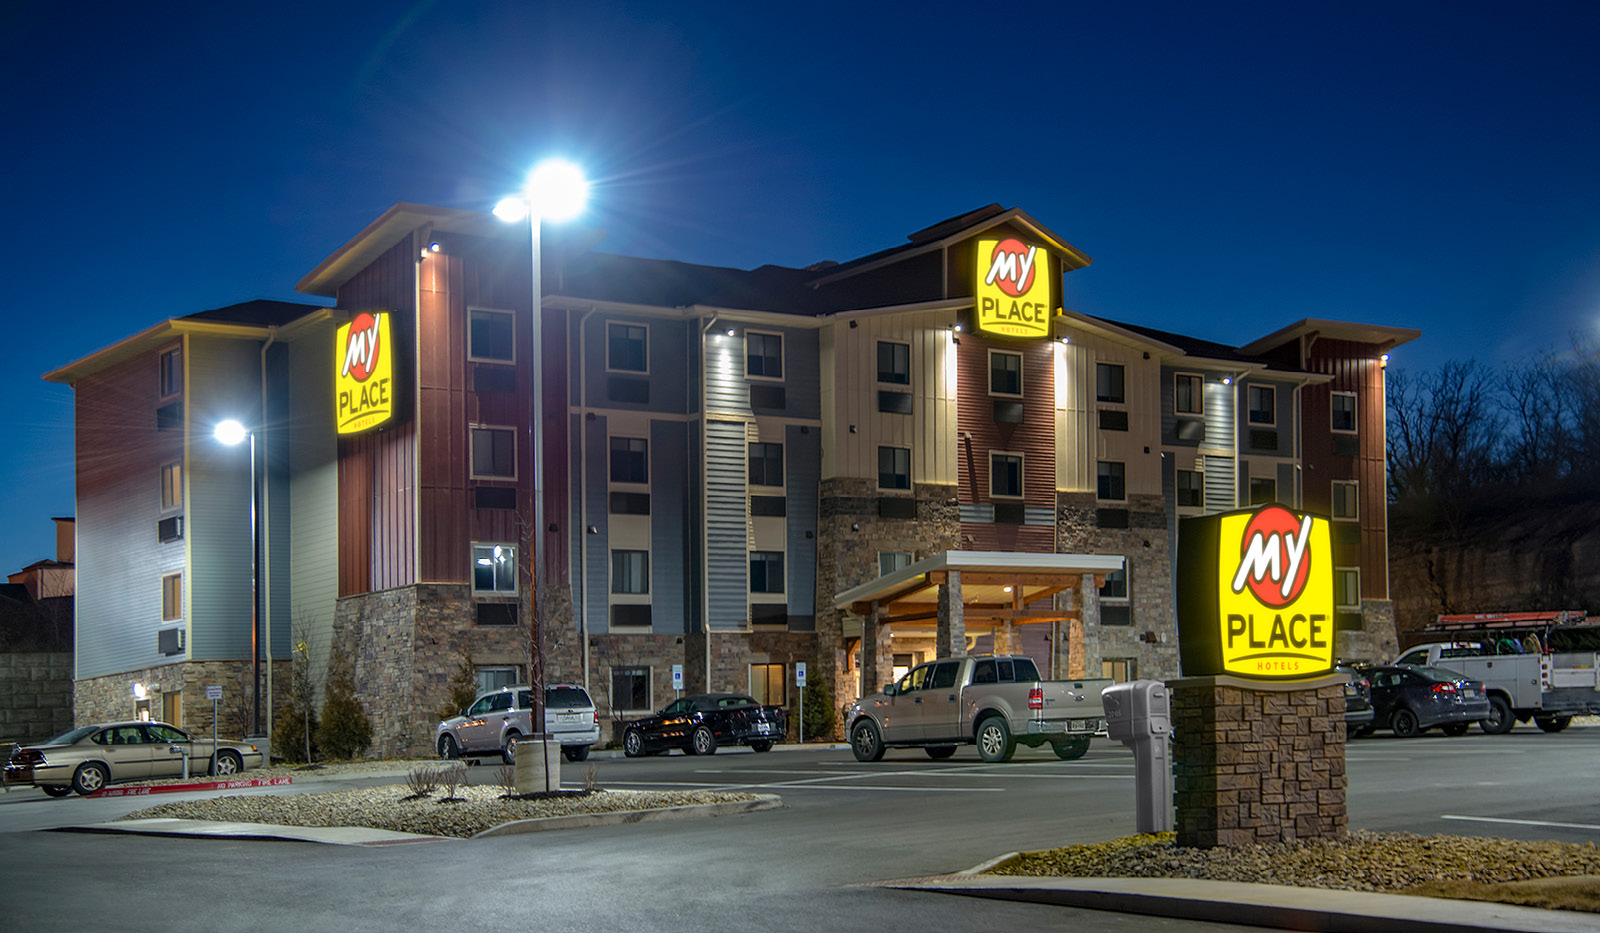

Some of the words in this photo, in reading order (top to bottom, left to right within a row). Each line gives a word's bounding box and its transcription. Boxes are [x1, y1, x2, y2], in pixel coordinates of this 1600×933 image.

[982, 297, 1046, 324] PLACE
[1001, 327, 1029, 335] HOTELS
[339, 378, 390, 418] PLACE
[354, 417, 376, 430] HOTELS
[1227, 613, 1327, 649] PLACE
[1257, 661, 1300, 671] HOTELS
[228, 780, 252, 789] PARKING
[258, 778, 272, 786] FIRE
[274, 777, 291, 785] LANE
